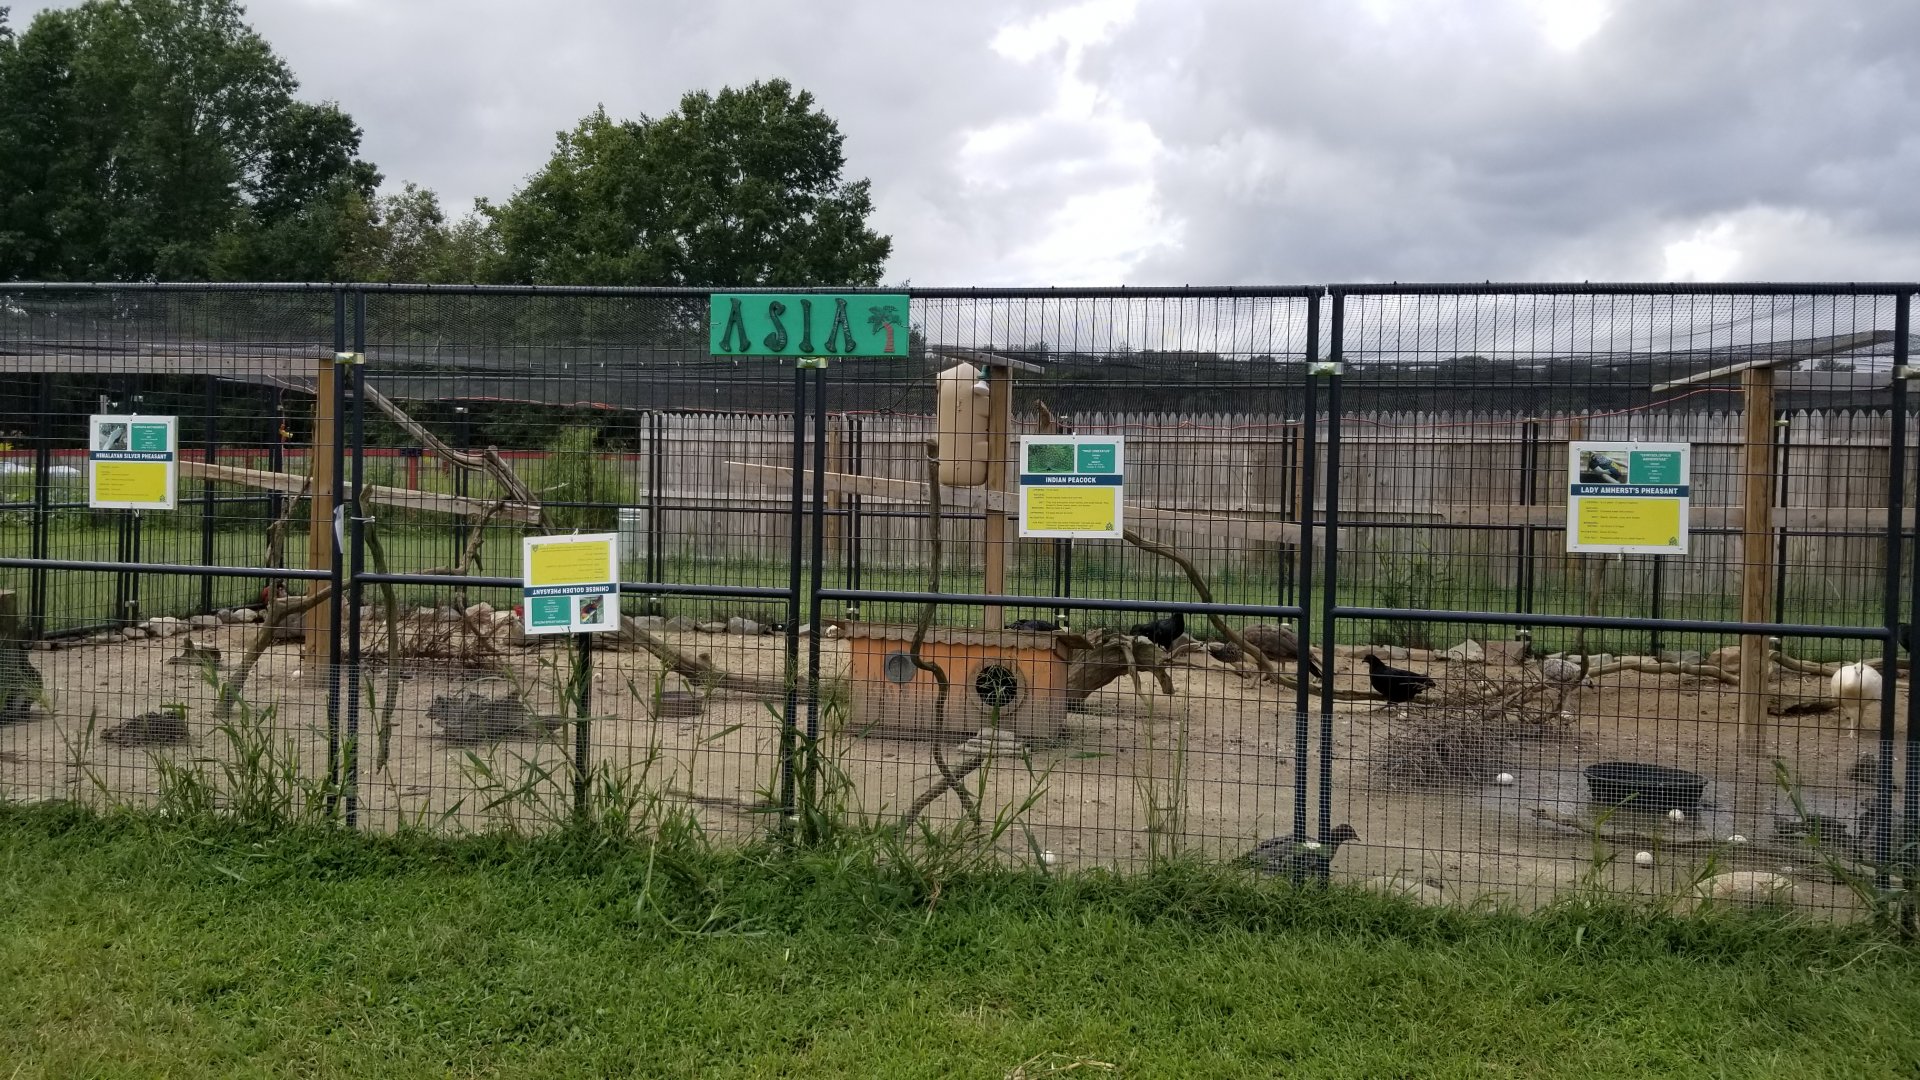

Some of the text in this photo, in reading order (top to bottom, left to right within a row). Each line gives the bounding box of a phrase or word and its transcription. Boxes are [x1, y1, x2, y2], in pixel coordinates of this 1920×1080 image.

[719, 297, 857, 353] ASIA
[1045, 476, 1097, 484] INDIAN PEACOCK
[1580, 486, 1679, 495] LADY AMHERST'S PHEASANT
[532, 585, 610, 596] CHINESE GOLDEN PHEASANT
